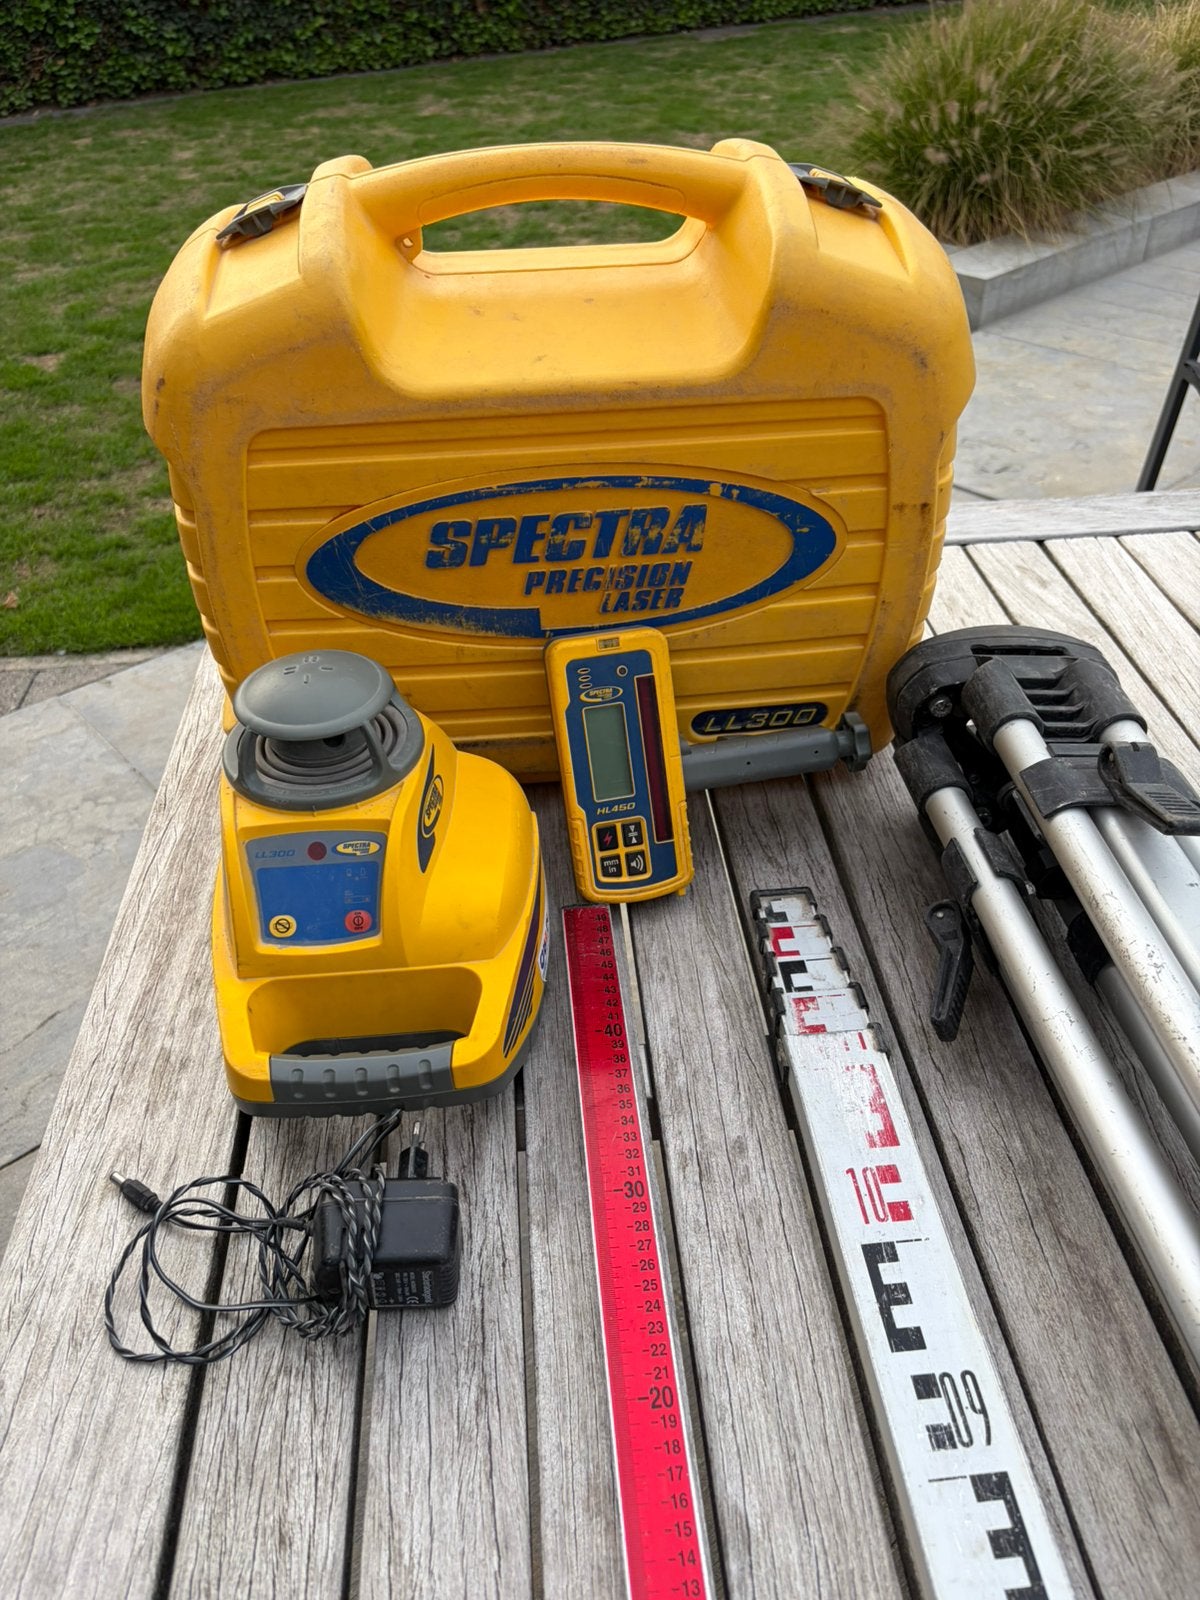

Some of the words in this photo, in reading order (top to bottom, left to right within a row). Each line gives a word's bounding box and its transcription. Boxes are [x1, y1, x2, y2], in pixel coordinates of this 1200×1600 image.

[425, 504, 708, 569] SPECTRA
[524, 560, 693, 596] PRECISION
[600, 587, 685, 613] LASER
[704, 708, 817, 732] LL300
[597, 802, 636, 815] HL450
[255, 849, 296, 859] LL300
[603, 859, 620, 867] mm
[608, 866, 617, 874] in
[595, 914, 606, 922] 49
[598, 936, 609, 944] 47
[602, 973, 614, 981] 44
[604, 986, 616, 994] 43
[606, 999, 618, 1007] 42
[608, 1012, 619, 1020] 41
[604, 1023, 622, 1037] 40
[611, 1040, 624, 1049] 39
[613, 1054, 626, 1063] 38
[615, 1069, 628, 1078] 37
[617, 1084, 631, 1094] 36
[619, 1100, 632, 1109] 35
[621, 1115, 634, 1126] 34
[623, 1132, 637, 1142] 33
[625, 1149, 640, 1159] 32
[627, 1166, 641, 1177] 31
[624, 1180, 644, 1198] 30
[846, 1166, 888, 1224] 10
[632, 1202, 647, 1213] 29
[634, 1220, 649, 1232] 28
[637, 1239, 651, 1251] 27
[640, 1259, 655, 1271] 26
[642, 1279, 658, 1292] 25
[645, 1300, 661, 1312] 24
[648, 1321, 664, 1334] 23
[650, 1344, 667, 1357] 22
[653, 1365, 668, 1380] 21
[650, 1386, 673, 1410] 20
[938, 1370, 991, 1448] 09
[660, 1414, 677, 1428] 19
[663, 1439, 681, 1455] 18
[667, 1465, 683, 1481] 17
[670, 1493, 688, 1509] 16
[674, 1520, 692, 1537] 15
[678, 1550, 696, 1567] 14
[682, 1579, 700, 1597] 13
